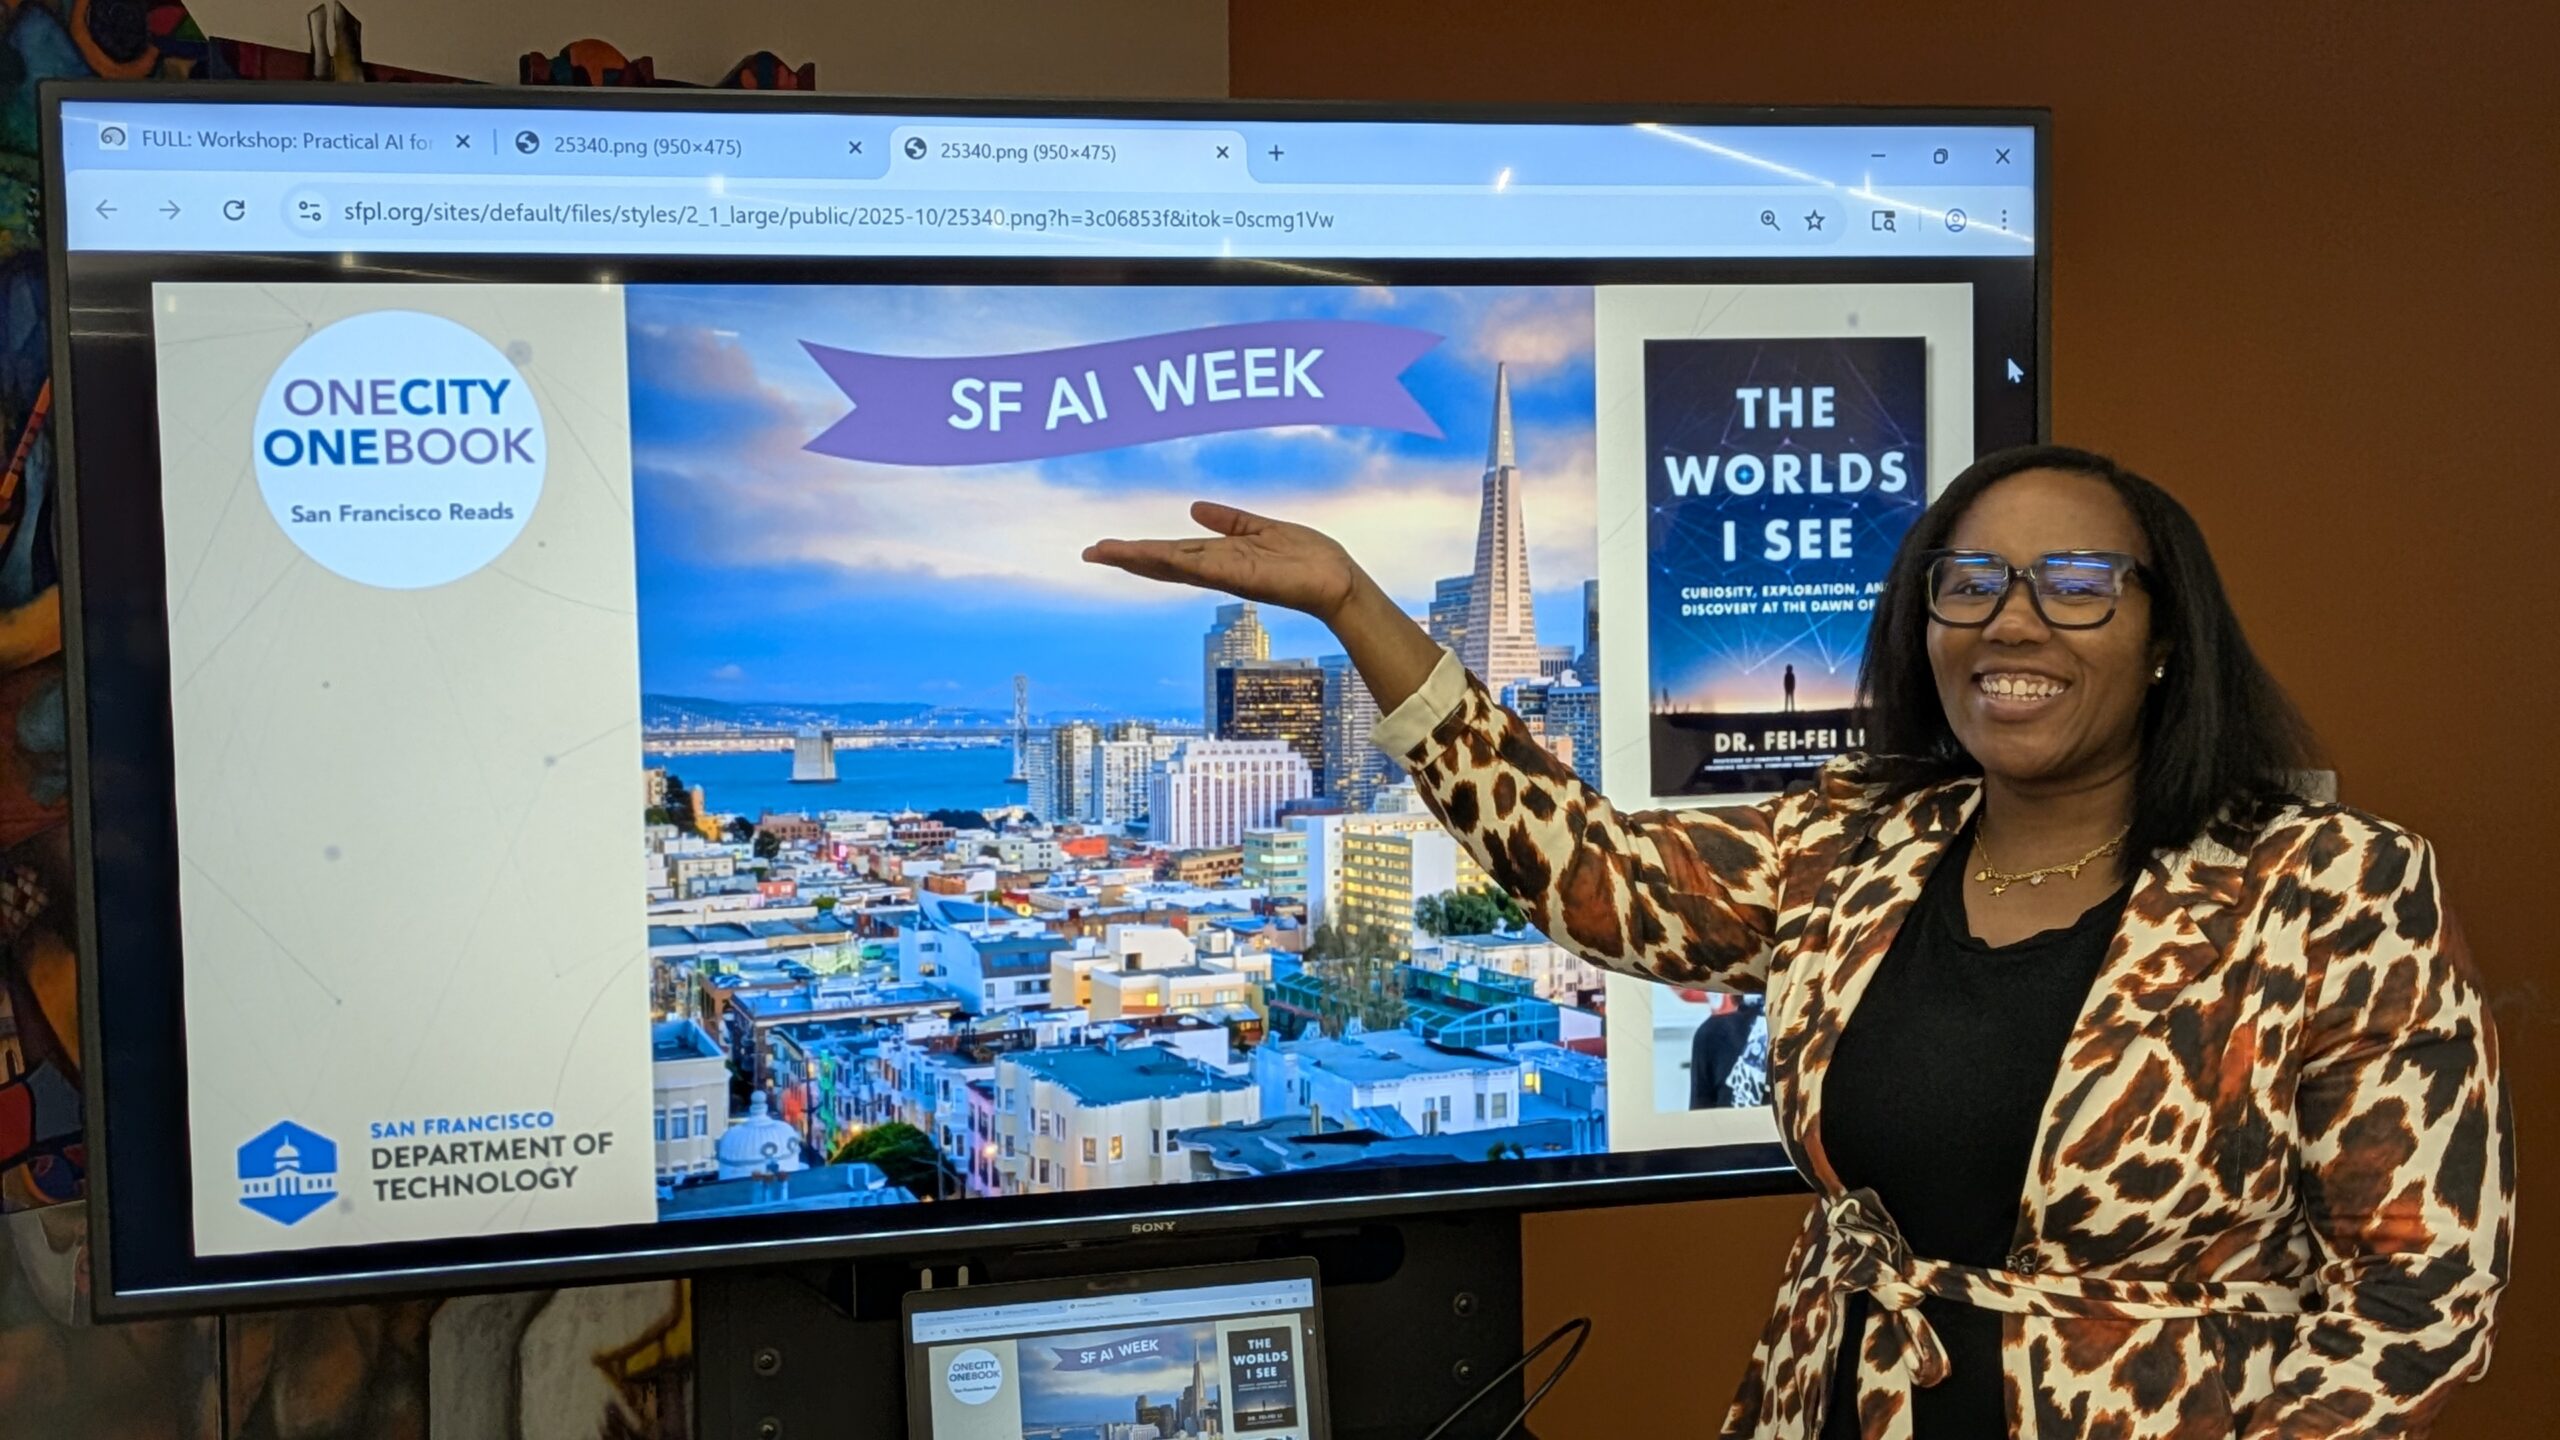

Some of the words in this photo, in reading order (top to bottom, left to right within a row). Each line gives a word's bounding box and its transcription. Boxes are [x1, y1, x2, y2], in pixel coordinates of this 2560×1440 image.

[142, 130, 193, 148] FULL:
[198, 131, 297, 152] Workshop:
[303, 132, 380, 150] Practical
[384, 133, 404, 150] AI
[554, 136, 648, 159] 25340.png
[940, 142, 1029, 164] 25340.png
[283, 378, 511, 417] ONECITY
[947, 377, 1023, 433] SF
[1045, 370, 1108, 431] AI
[1133, 347, 1325, 413] WEEK
[1735, 386, 1836, 429] THE
[263, 427, 535, 467] ONEBOOK
[1664, 451, 1908, 497] WORLDS
[291, 504, 331, 523] San
[339, 503, 442, 522] Francisco
[449, 501, 515, 521] Reads
[1723, 520, 1736, 562] I
[1764, 518, 1854, 561] SEE
[1681, 586, 1757, 600] CURIOSITY,
[1762, 582, 1860, 597] EXPLORATION,
[1864, 581, 1889, 595] AN
[1681, 602, 1758, 616] DISCOVERY
[1762, 602, 1778, 613] AT
[1783, 601, 1807, 613] THE
[1811, 600, 1854, 612] DAWN
[1715, 732, 1755, 753] DR.
[1764, 729, 1837, 751] FEI-FEI
[370, 1122, 416, 1140] SAN
[424, 1111, 555, 1136] FRANCISCO
[371, 1135, 567, 1171] DEPARTMENT
[574, 1132, 614, 1156] OF
[373, 1165, 580, 1202] TECHNOLOGY
[1131, 1221, 1177, 1234] SONY
[1080, 1352, 1097, 1364] SF
[1100, 1347, 1114, 1362] AI
[1118, 1339, 1160, 1357] WEEK
[1247, 1337, 1272, 1350] THE
[1232, 1350, 1289, 1367] WORLDS
[1246, 1368, 1251, 1380] I
[1256, 1366, 1278, 1379] SEE
